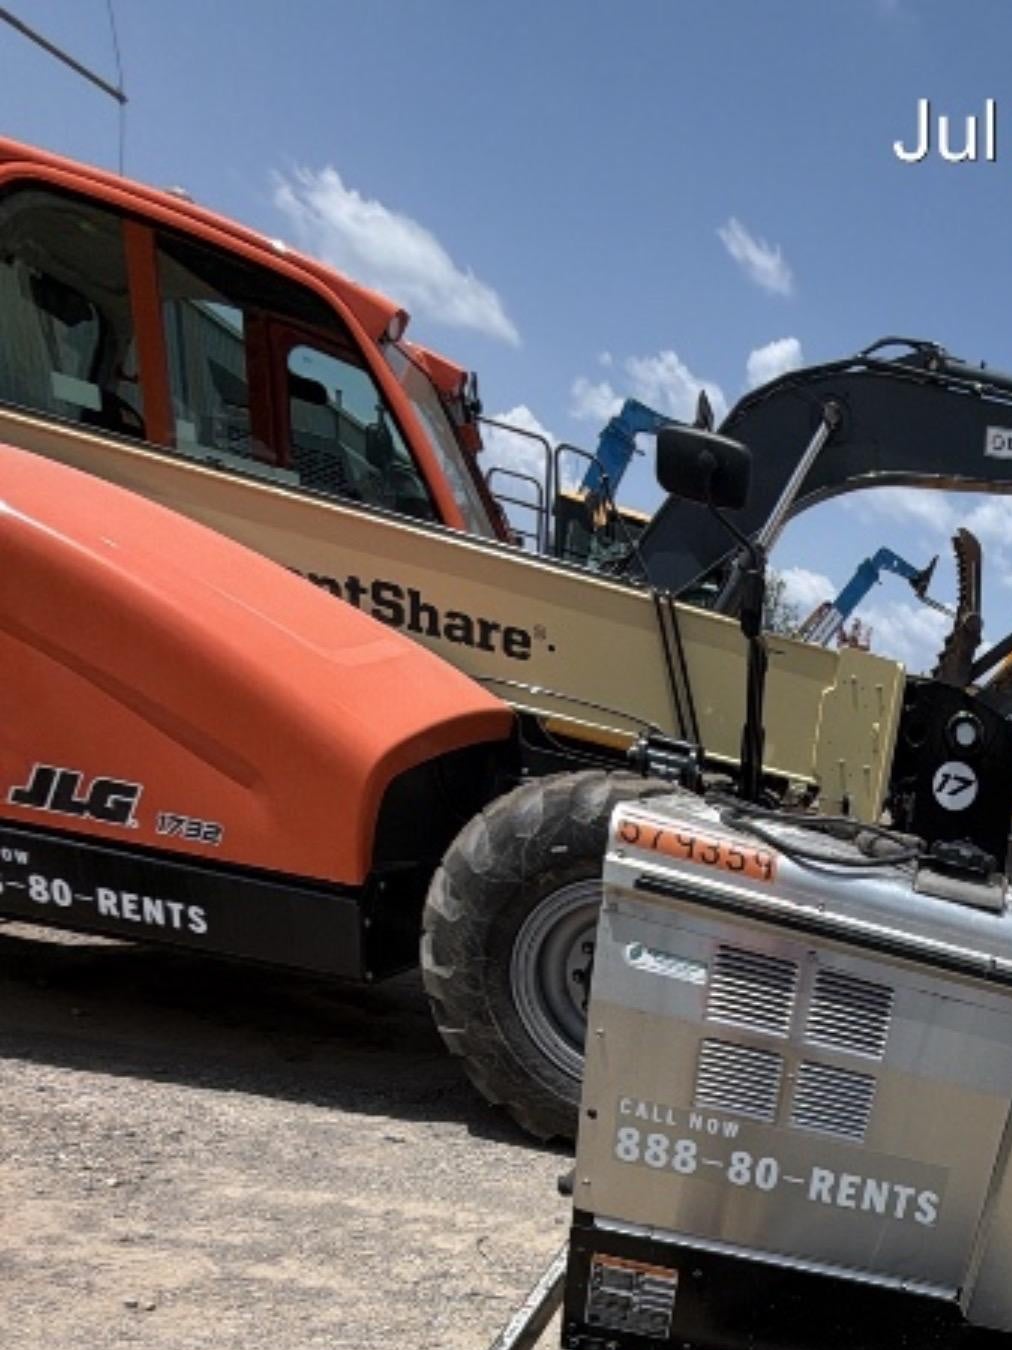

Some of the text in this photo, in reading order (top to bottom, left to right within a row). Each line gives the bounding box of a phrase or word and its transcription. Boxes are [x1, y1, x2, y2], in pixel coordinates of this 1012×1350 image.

[9, 763, 144, 824] JLG
[936, 773, 977, 796] 17
[156, 812, 224, 846] 1732
[0, 874, 208, 934] -80-RENTS
[619, 1098, 739, 1138] CALL NOW
[615, 1126, 939, 1226] 888-80-RENTS
